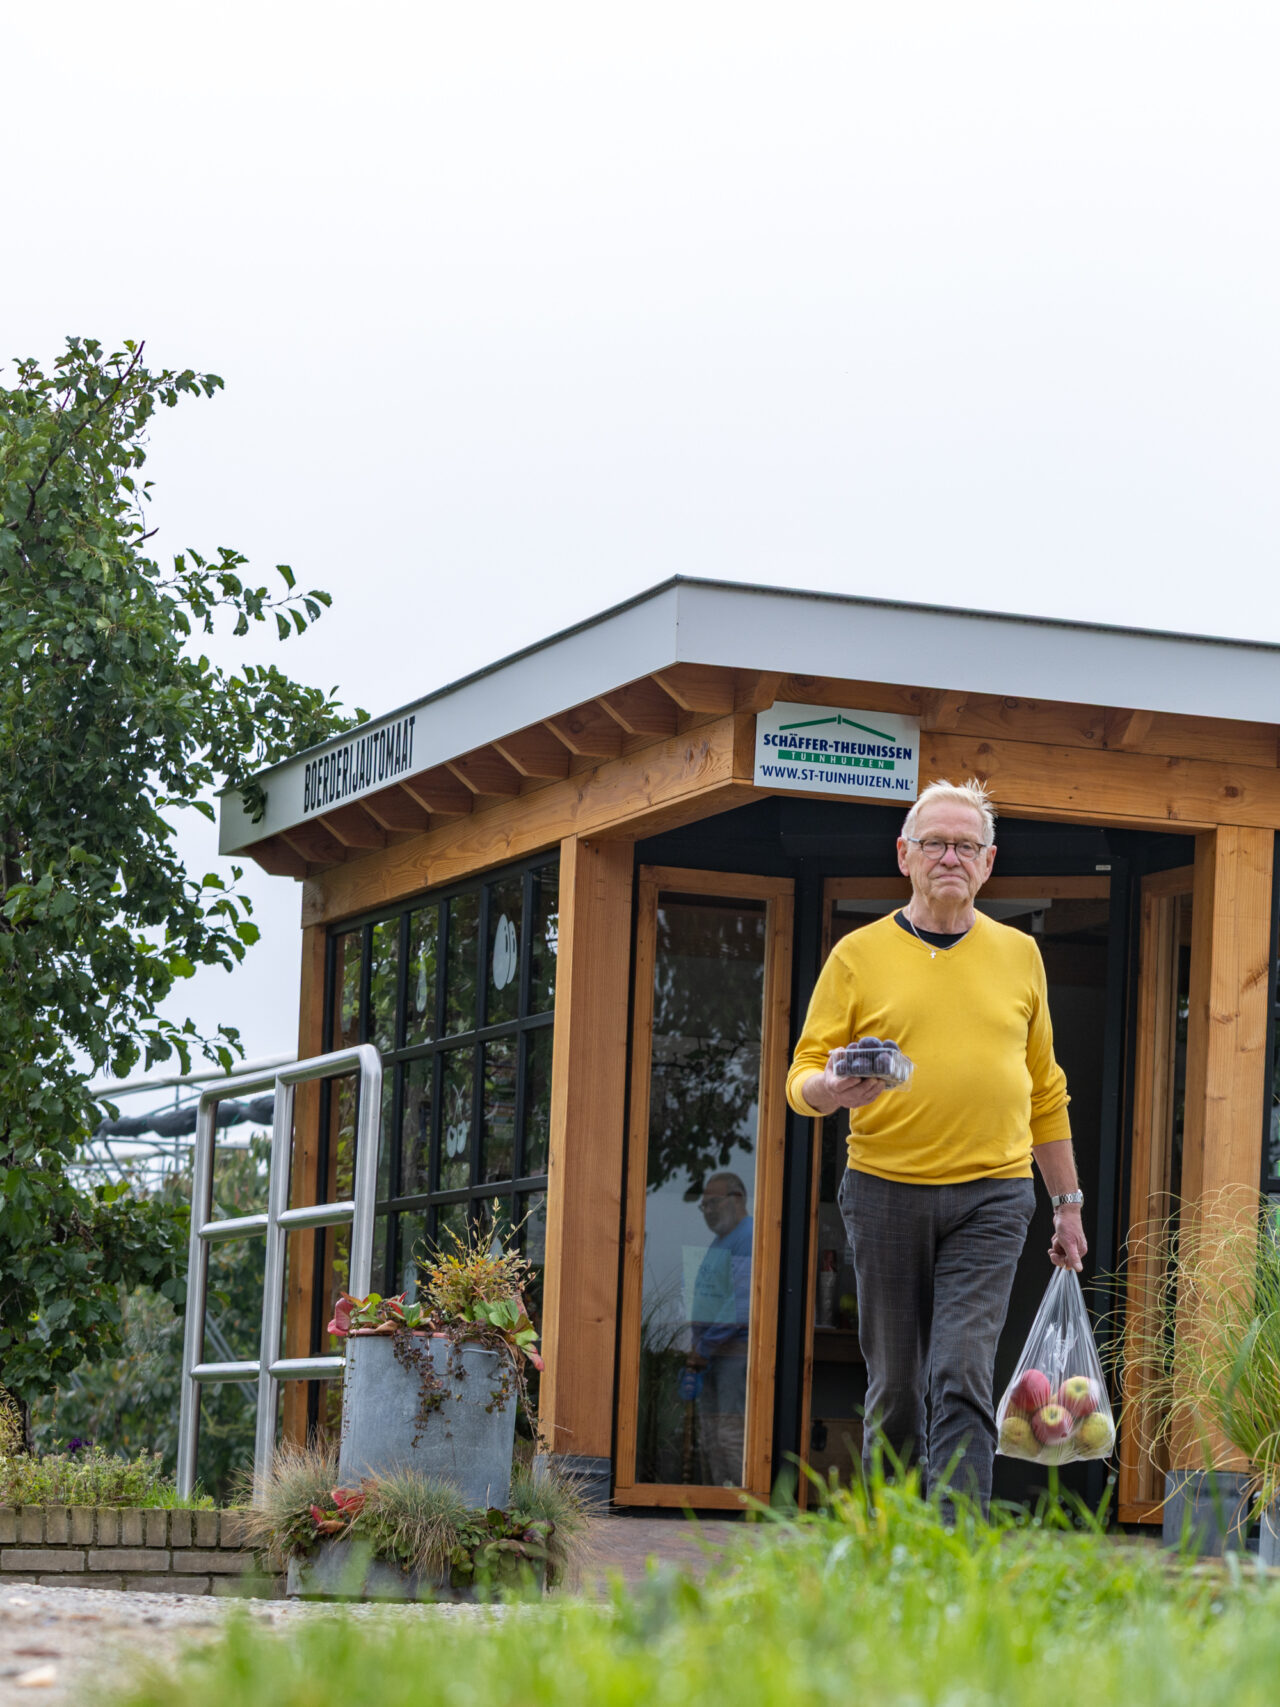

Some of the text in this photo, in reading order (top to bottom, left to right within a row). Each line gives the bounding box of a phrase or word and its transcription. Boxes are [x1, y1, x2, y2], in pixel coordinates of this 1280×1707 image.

[763, 732, 912, 760] SCHÄFFER-THEUNISSEN
[303, 715, 416, 814] BOERDERIJAUTOMAAT
[791, 751, 885, 769] TUINHUIZEN
[761, 765, 911, 791] WWW.ST-TUINHUIZEN.NL
